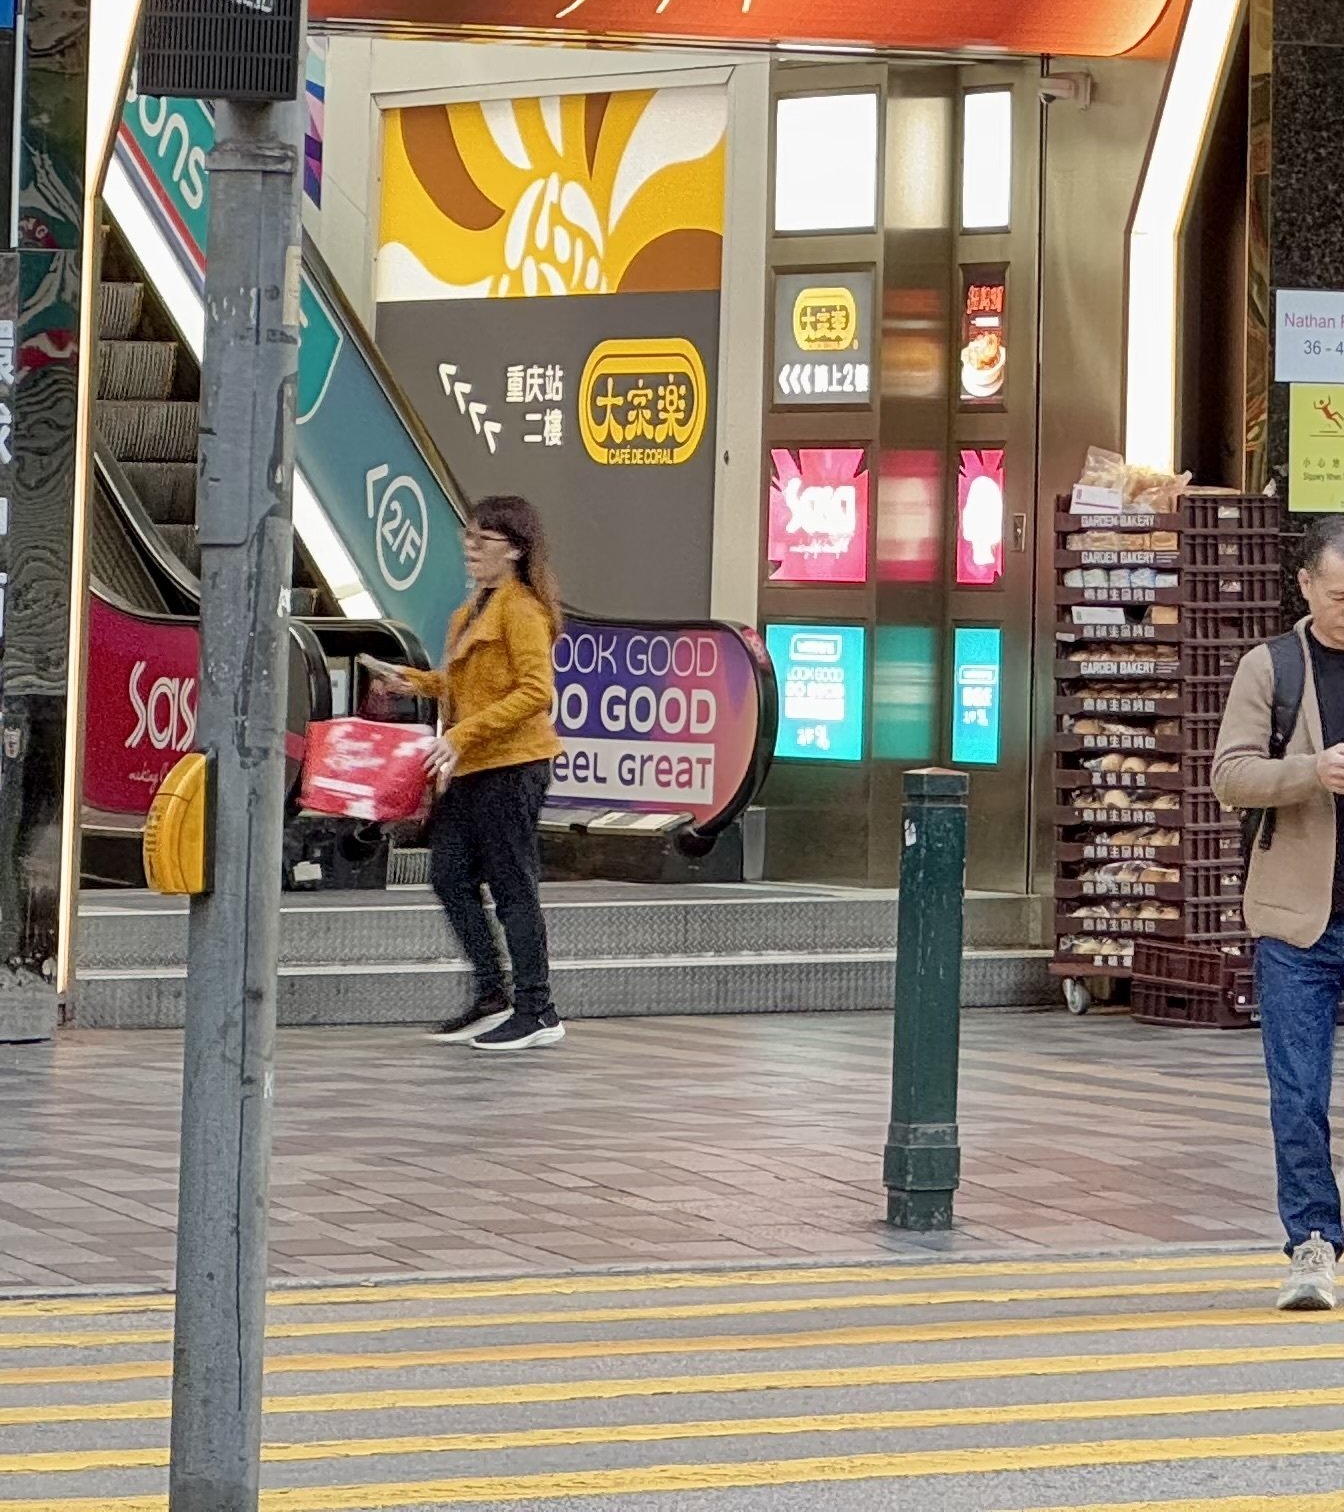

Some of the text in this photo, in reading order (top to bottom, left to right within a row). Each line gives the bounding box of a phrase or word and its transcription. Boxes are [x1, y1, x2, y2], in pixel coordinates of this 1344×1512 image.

[1283, 312, 1336, 330] Nathan
[1303, 339, 1322, 355] 36
[505, 364, 565, 403] 重庆站
[631, 449, 644, 465] DE
[644, 449, 674, 465] CORAL
[1081, 514, 1155, 528] GARDEN BAKERY
[381, 500, 422, 565] 2/F
[1081, 551, 1156, 565] GARDEN BAKERY
[551, 632, 718, 677] OOK GOOD
[1080, 661, 1156, 676] GARDEN BAKERY
[125, 660, 199, 752] Sas
[600, 684, 718, 735] GOOD
